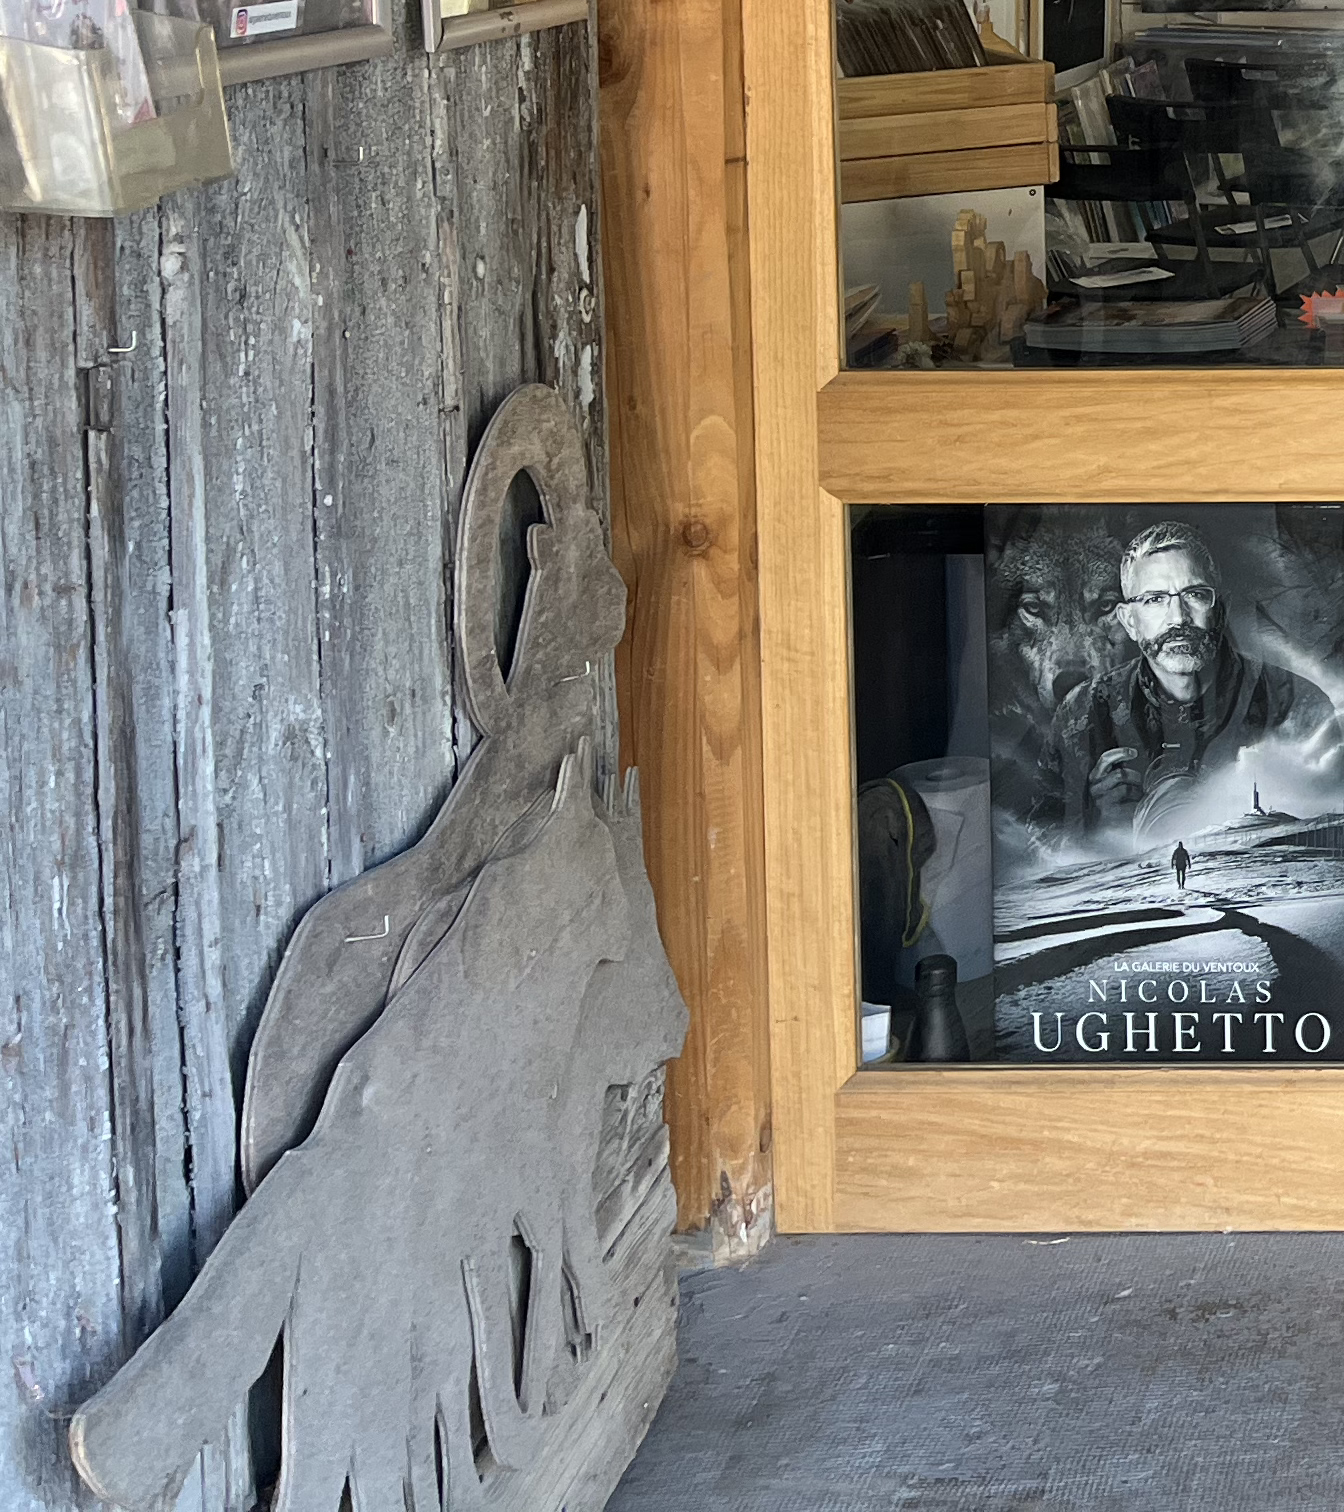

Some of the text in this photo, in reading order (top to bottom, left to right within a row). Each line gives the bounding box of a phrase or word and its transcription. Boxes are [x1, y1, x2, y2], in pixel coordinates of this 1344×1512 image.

[1114, 961, 1259, 973] LA GALERIE DU VENTOUX
[1088, 979, 1272, 1003] NICOLAS
[1031, 1012, 1331, 1053] UGHETTO
